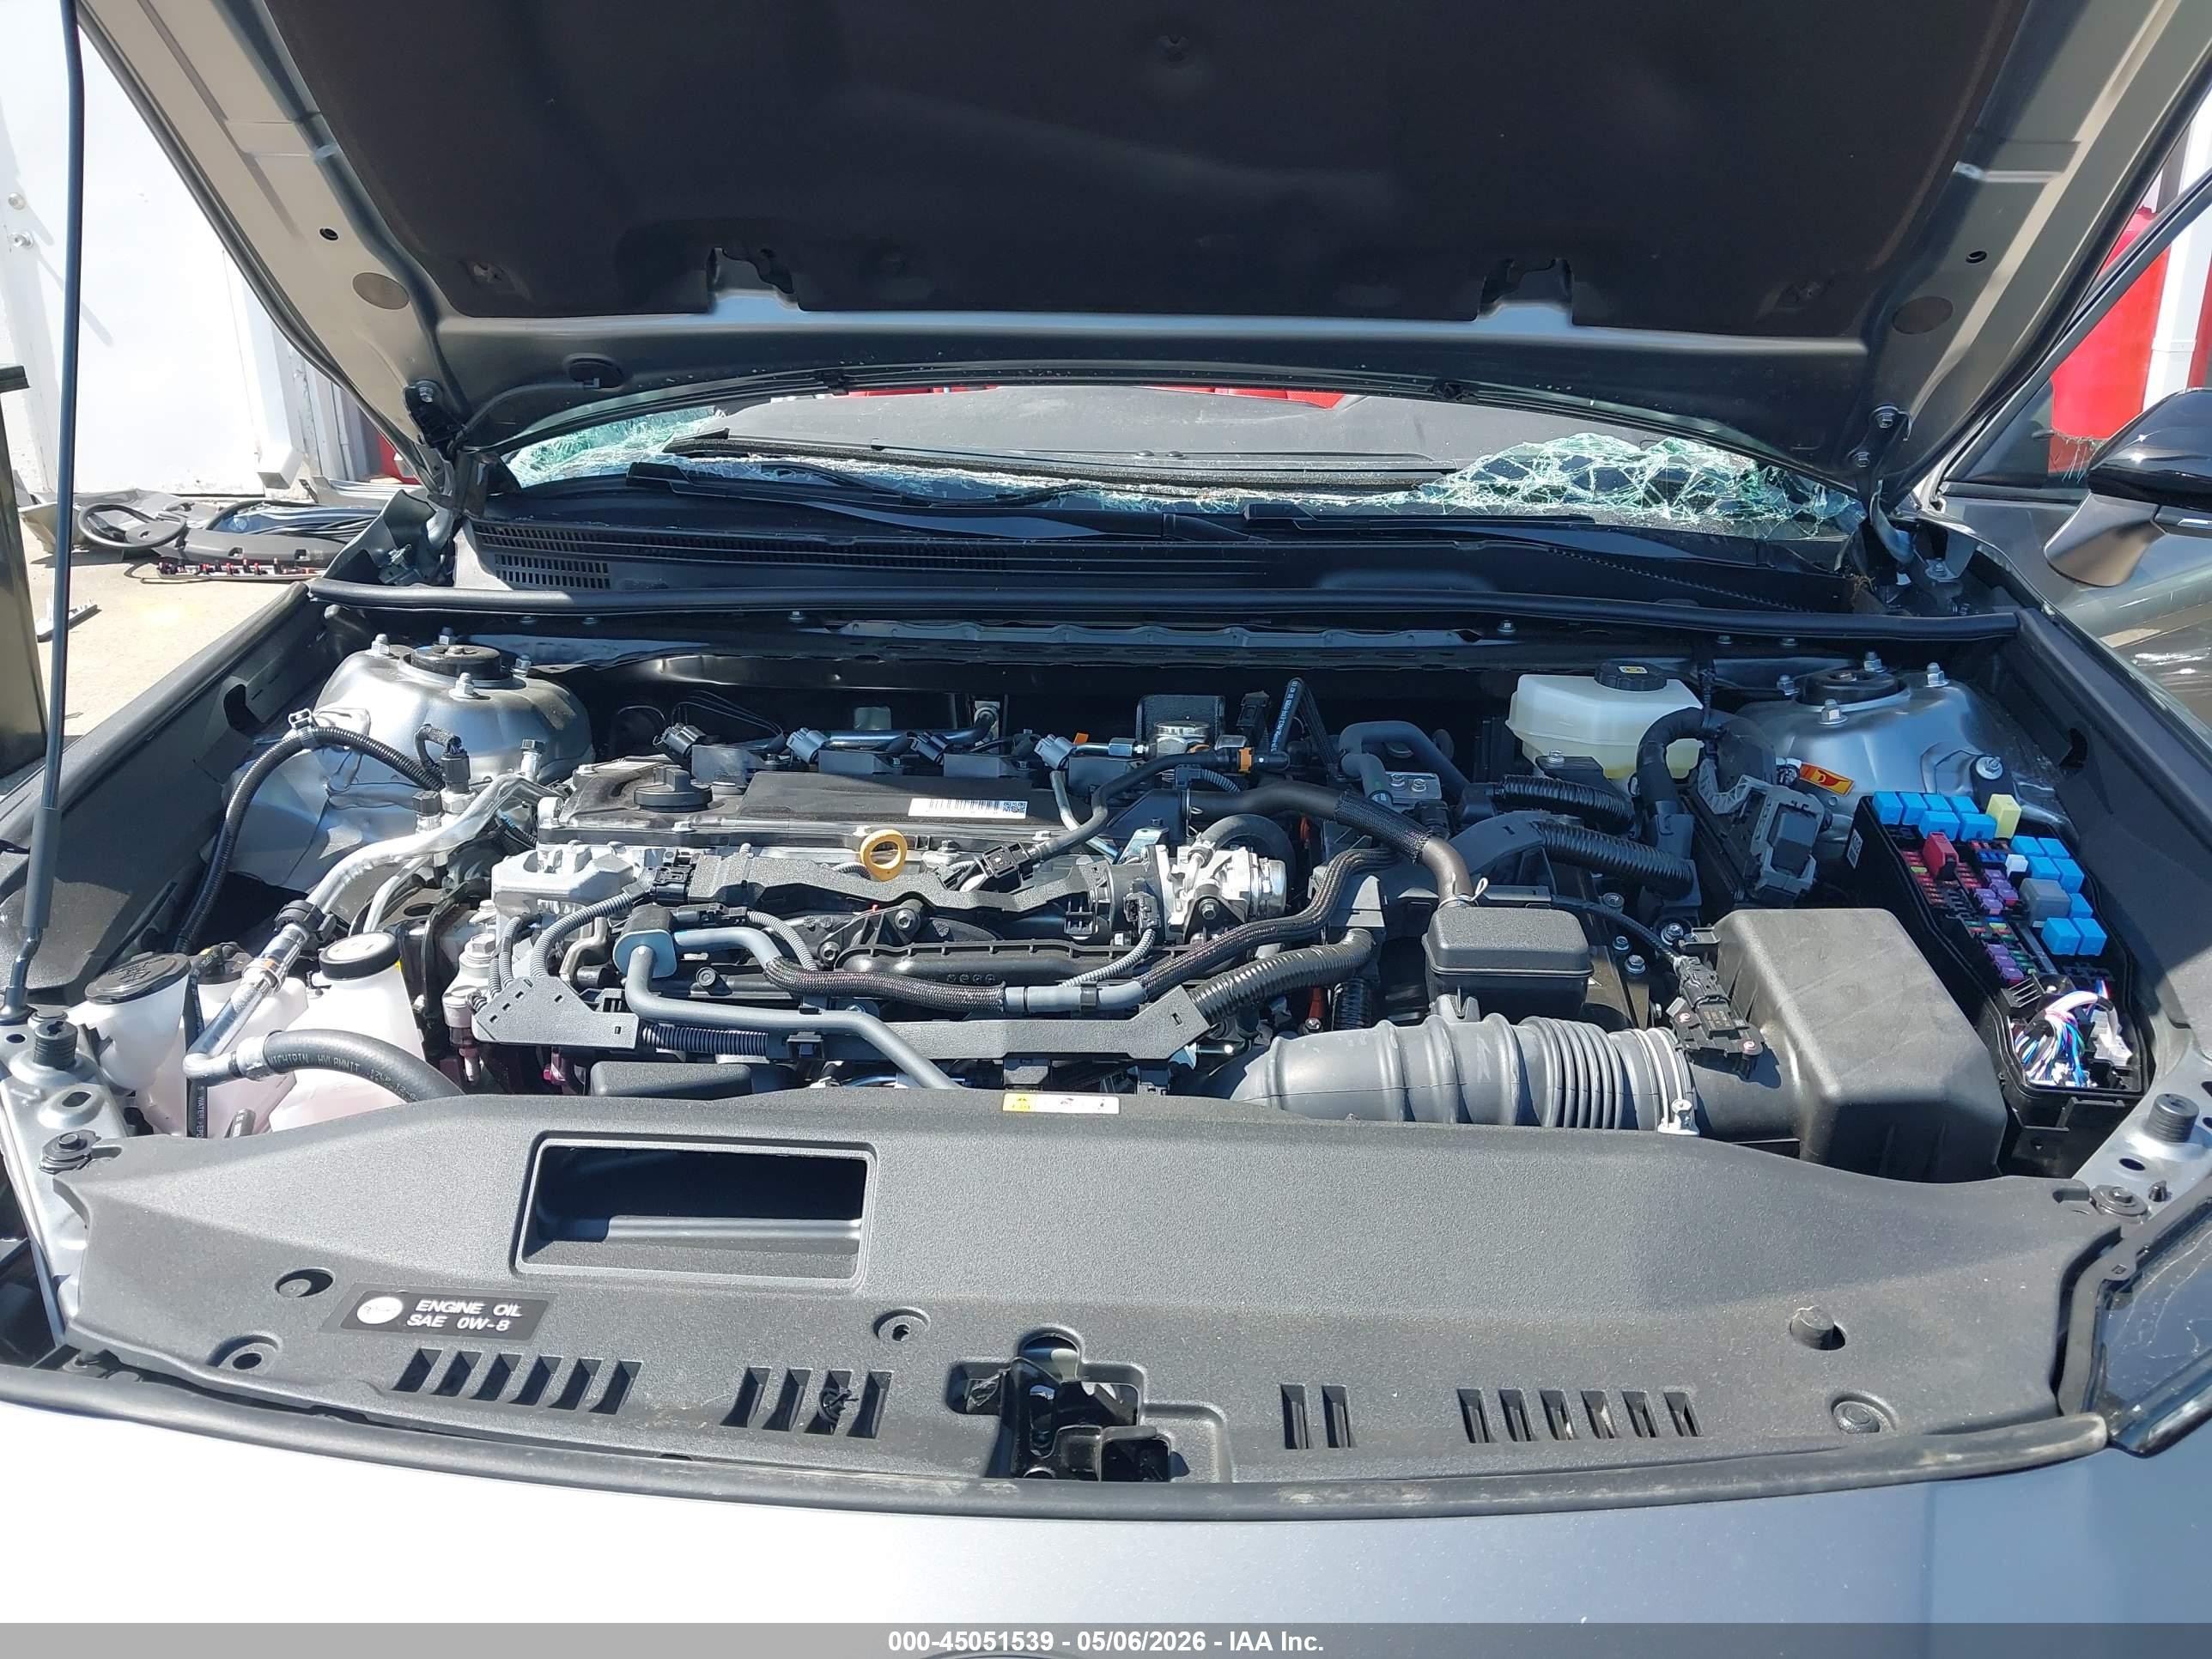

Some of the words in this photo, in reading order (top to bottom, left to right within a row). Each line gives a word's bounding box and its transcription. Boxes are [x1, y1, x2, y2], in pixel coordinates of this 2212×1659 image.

[416, 1299, 484, 1315] ENGINE
[493, 1304, 522, 1317] OIL
[407, 1314, 447, 1328] SAE
[457, 1316, 510, 1331] 0W-8
